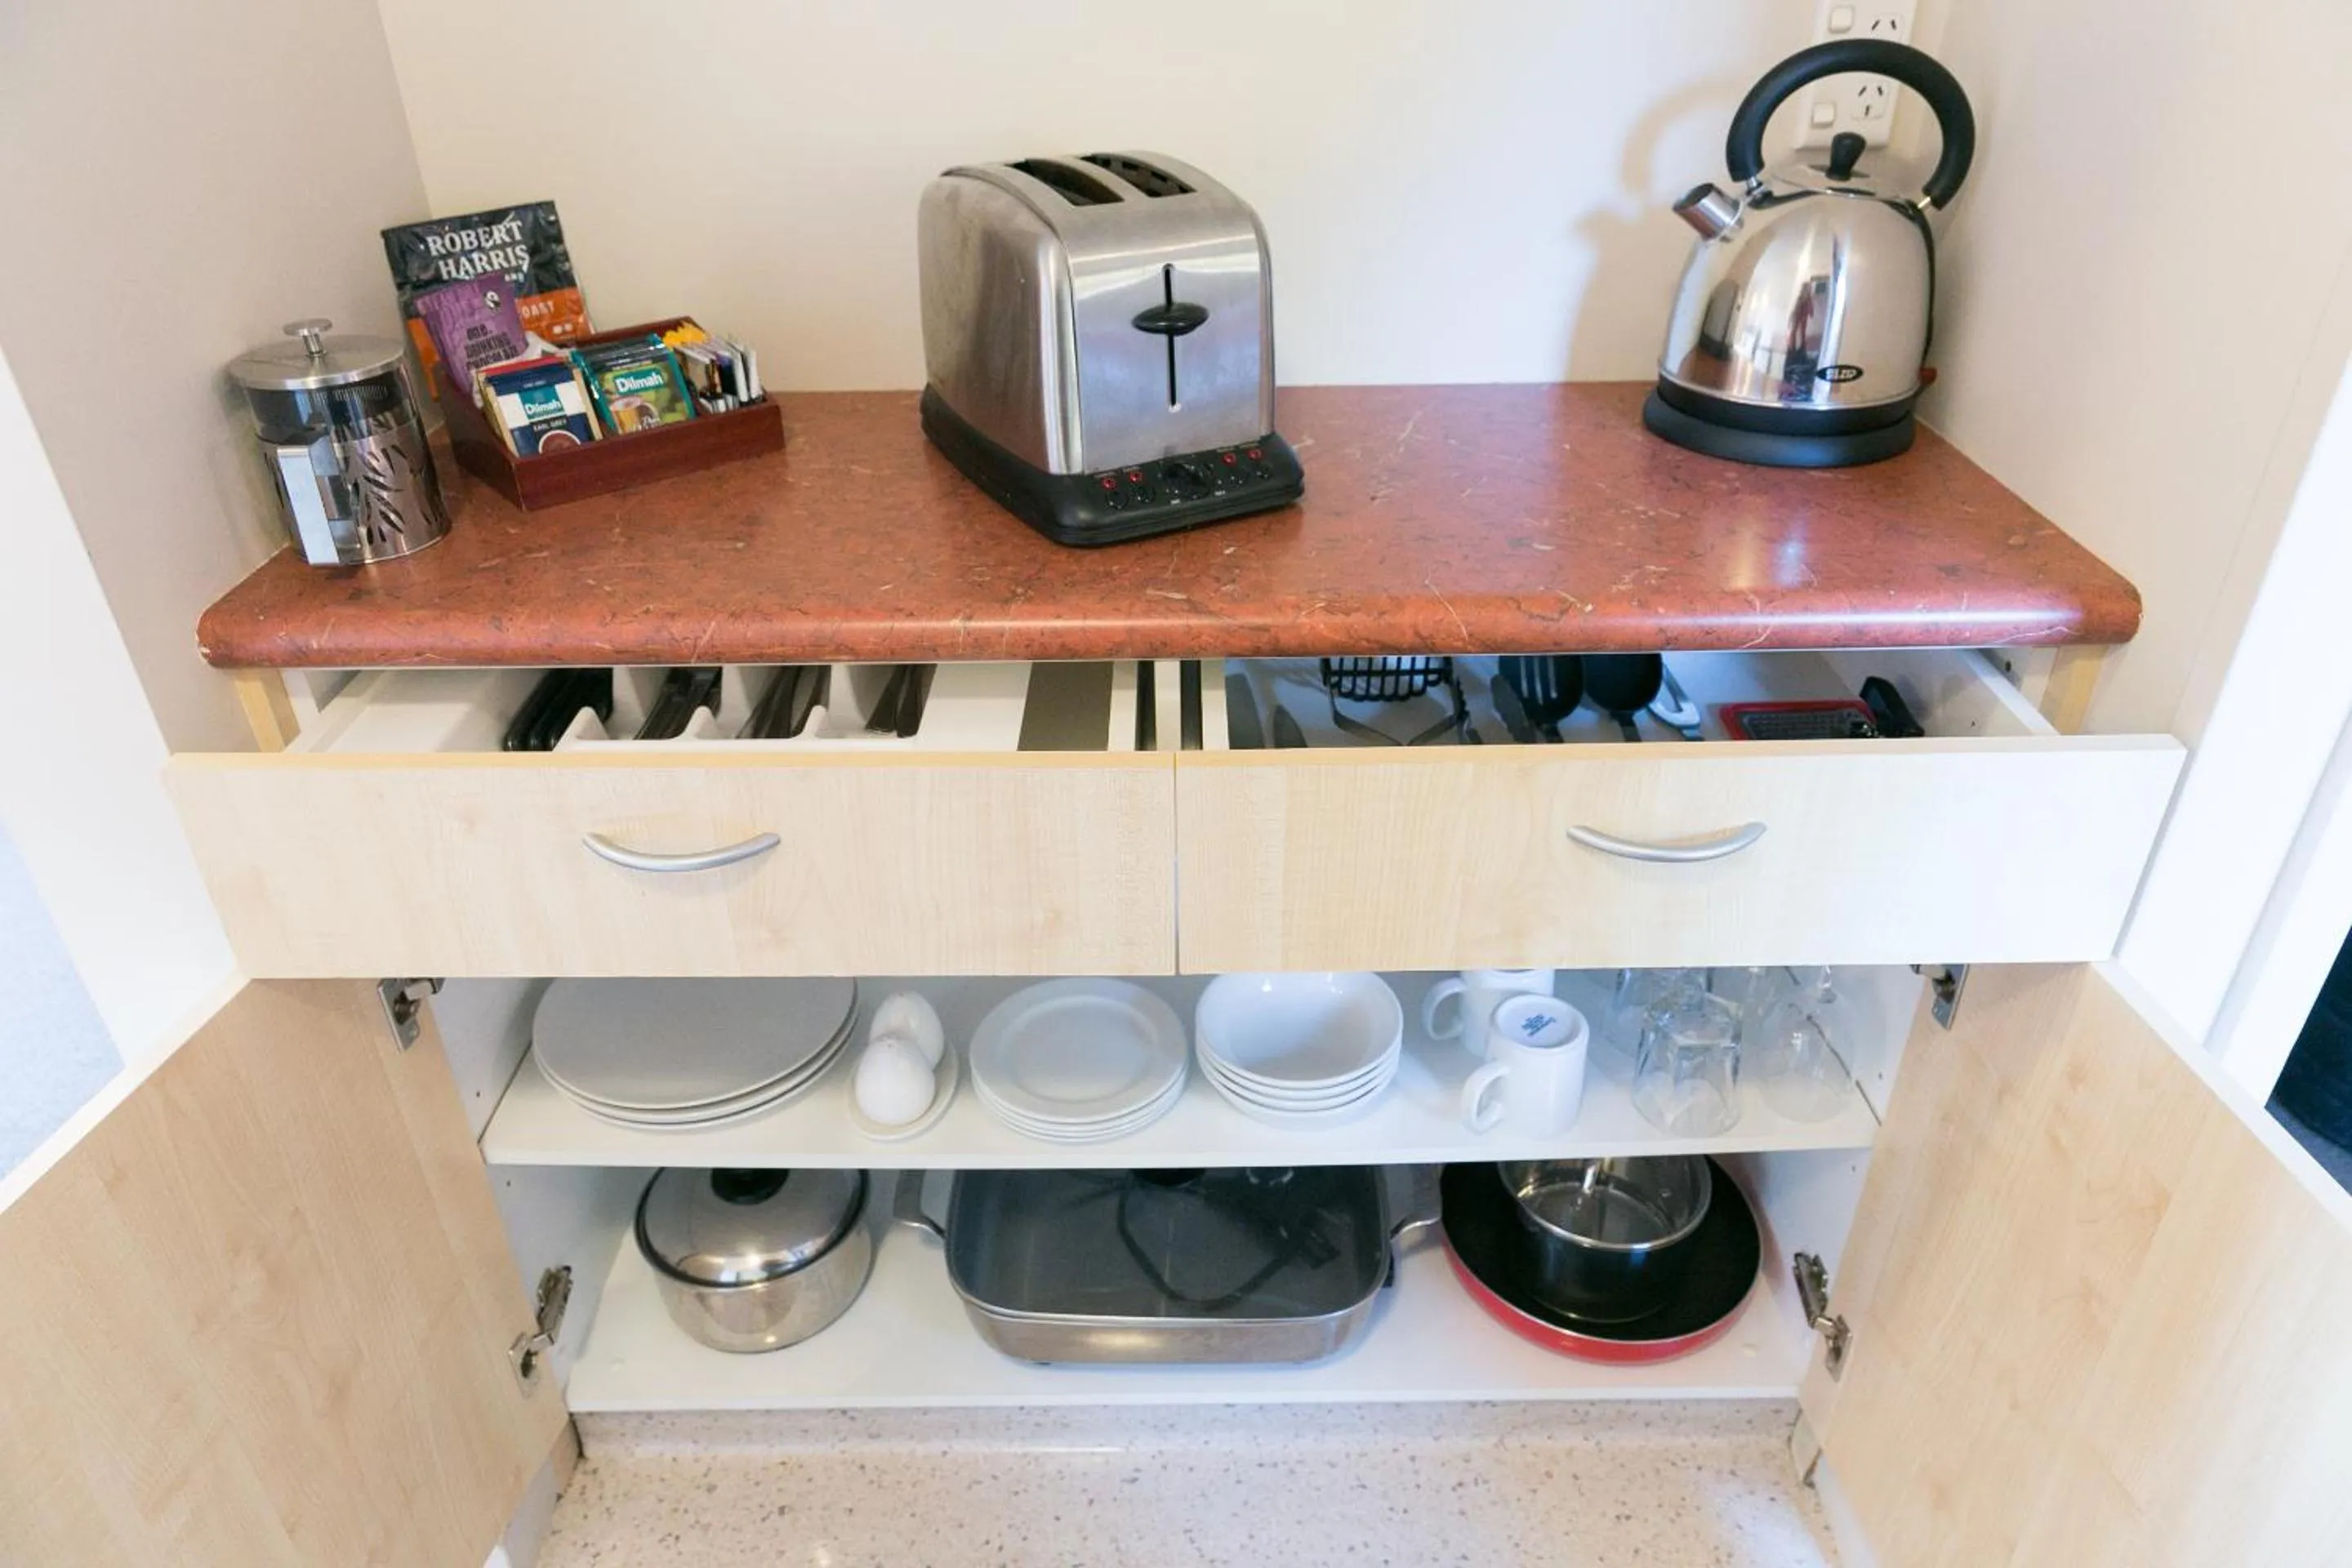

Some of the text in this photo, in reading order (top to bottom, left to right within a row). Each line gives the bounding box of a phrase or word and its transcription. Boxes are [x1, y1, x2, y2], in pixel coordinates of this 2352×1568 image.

[425, 220, 523, 256] ROBERT
[438, 244, 529, 280] HARRIS
[522, 300, 555, 319] OAST
[614, 372, 664, 393] Dilmah
[524, 399, 561, 415] Dilmah
